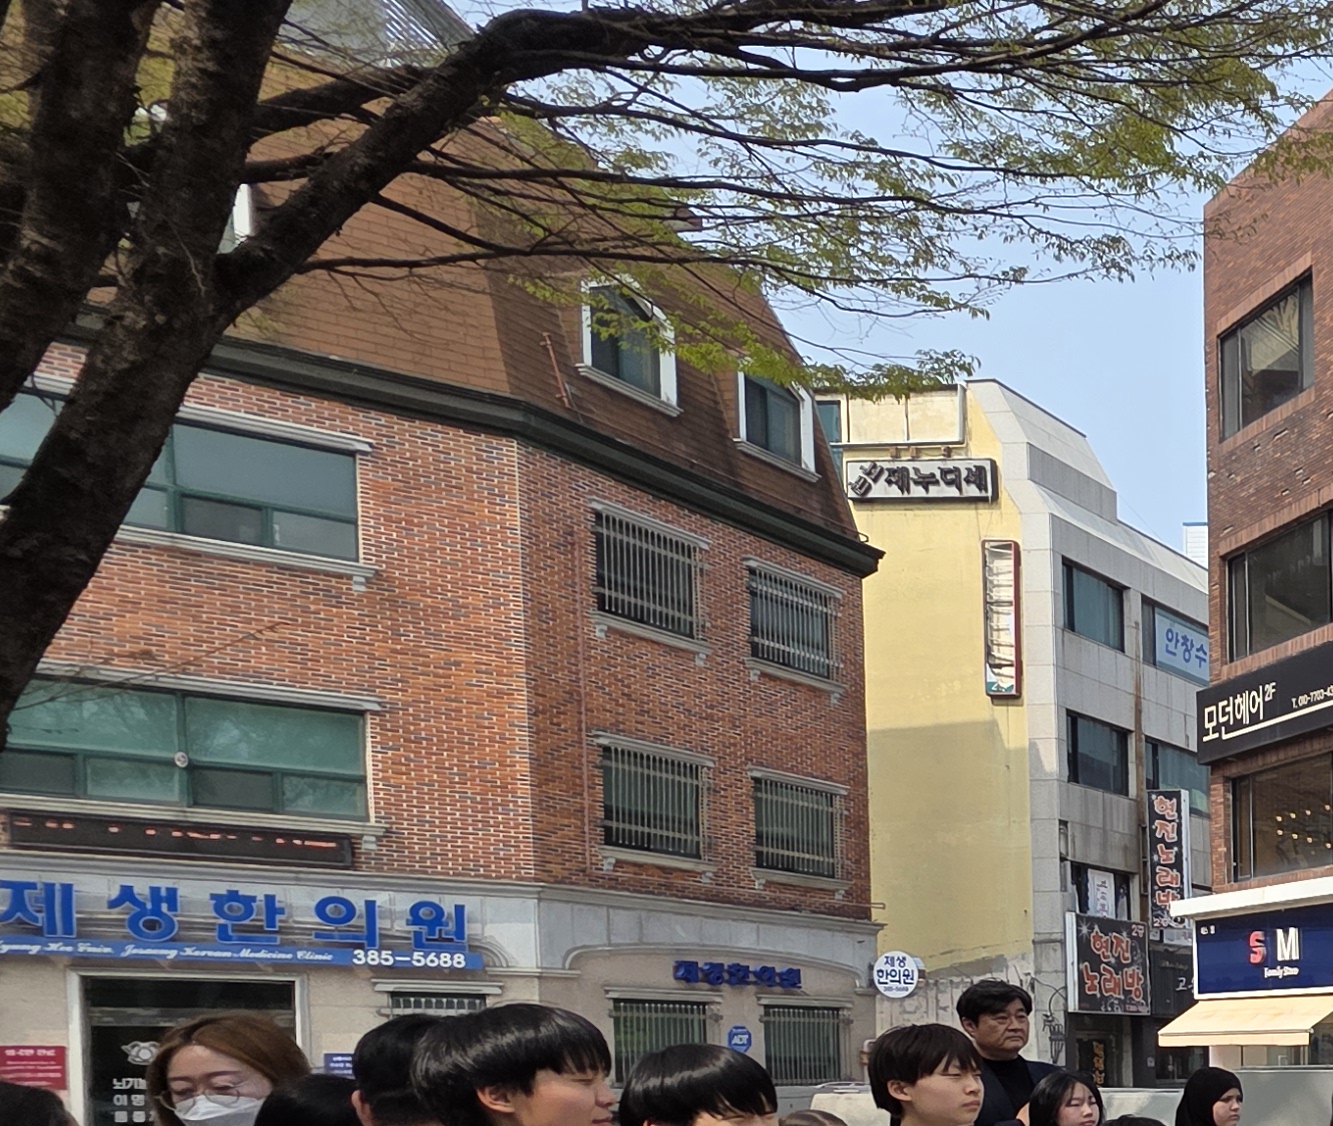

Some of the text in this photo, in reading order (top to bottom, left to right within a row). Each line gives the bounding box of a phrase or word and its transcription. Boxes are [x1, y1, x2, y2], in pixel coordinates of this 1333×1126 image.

[1165, 627, 1208, 669] 안창수
[1202, 682, 1278, 742] 모던헤어 2F
[0, 880, 468, 951] 제생한의원
[180, 946, 232, 958] Korean
[296, 950, 334, 962] Clinic
[352, 949, 467, 969] 385-5688
[1090, 929, 1131, 964] 현진
[884, 955, 907, 968] 제생
[876, 968, 915, 985] 한의원
[1082, 961, 1145, 1000] 노래방
[730, 1035, 749, 1045] ADT
